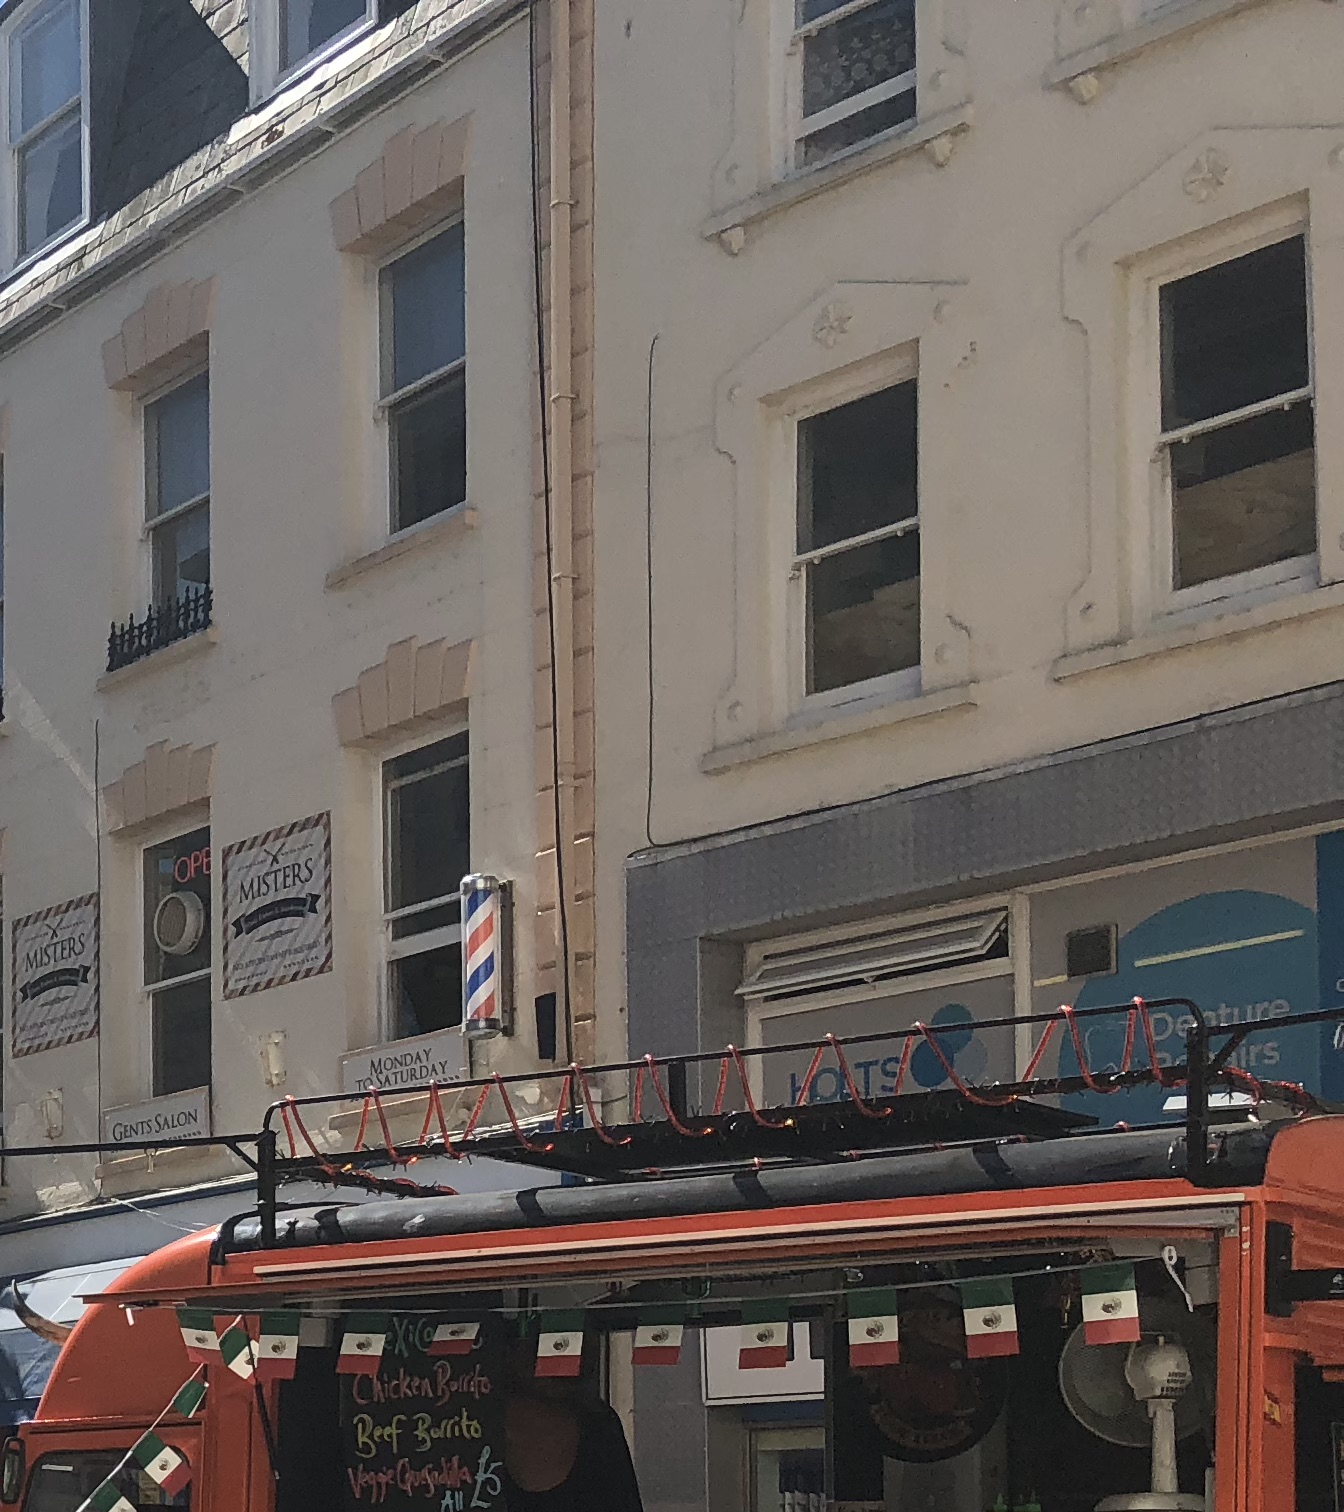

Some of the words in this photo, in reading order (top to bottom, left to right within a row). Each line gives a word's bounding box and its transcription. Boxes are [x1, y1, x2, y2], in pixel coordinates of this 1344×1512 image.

[238, 857, 314, 904] MISTERS
[24, 932, 85, 973] MISTERS
[1150, 998, 1291, 1041] Denture
[370, 1047, 433, 1076] MONDAY
[1150, 1040, 1281, 1070] Reairs
[355, 1076, 373, 1092] TO
[375, 1060, 448, 1090] SATURDAY
[789, 1056, 900, 1107] HOLTS
[112, 1118, 152, 1142] GENTS
[154, 1108, 198, 1134] SALON
[353, 1367, 433, 1406] Chicken
[352, 1413, 408, 1459] Beef
[412, 1407, 483, 1452] Burrito
[348, 1463, 396, 1504] Veggie
